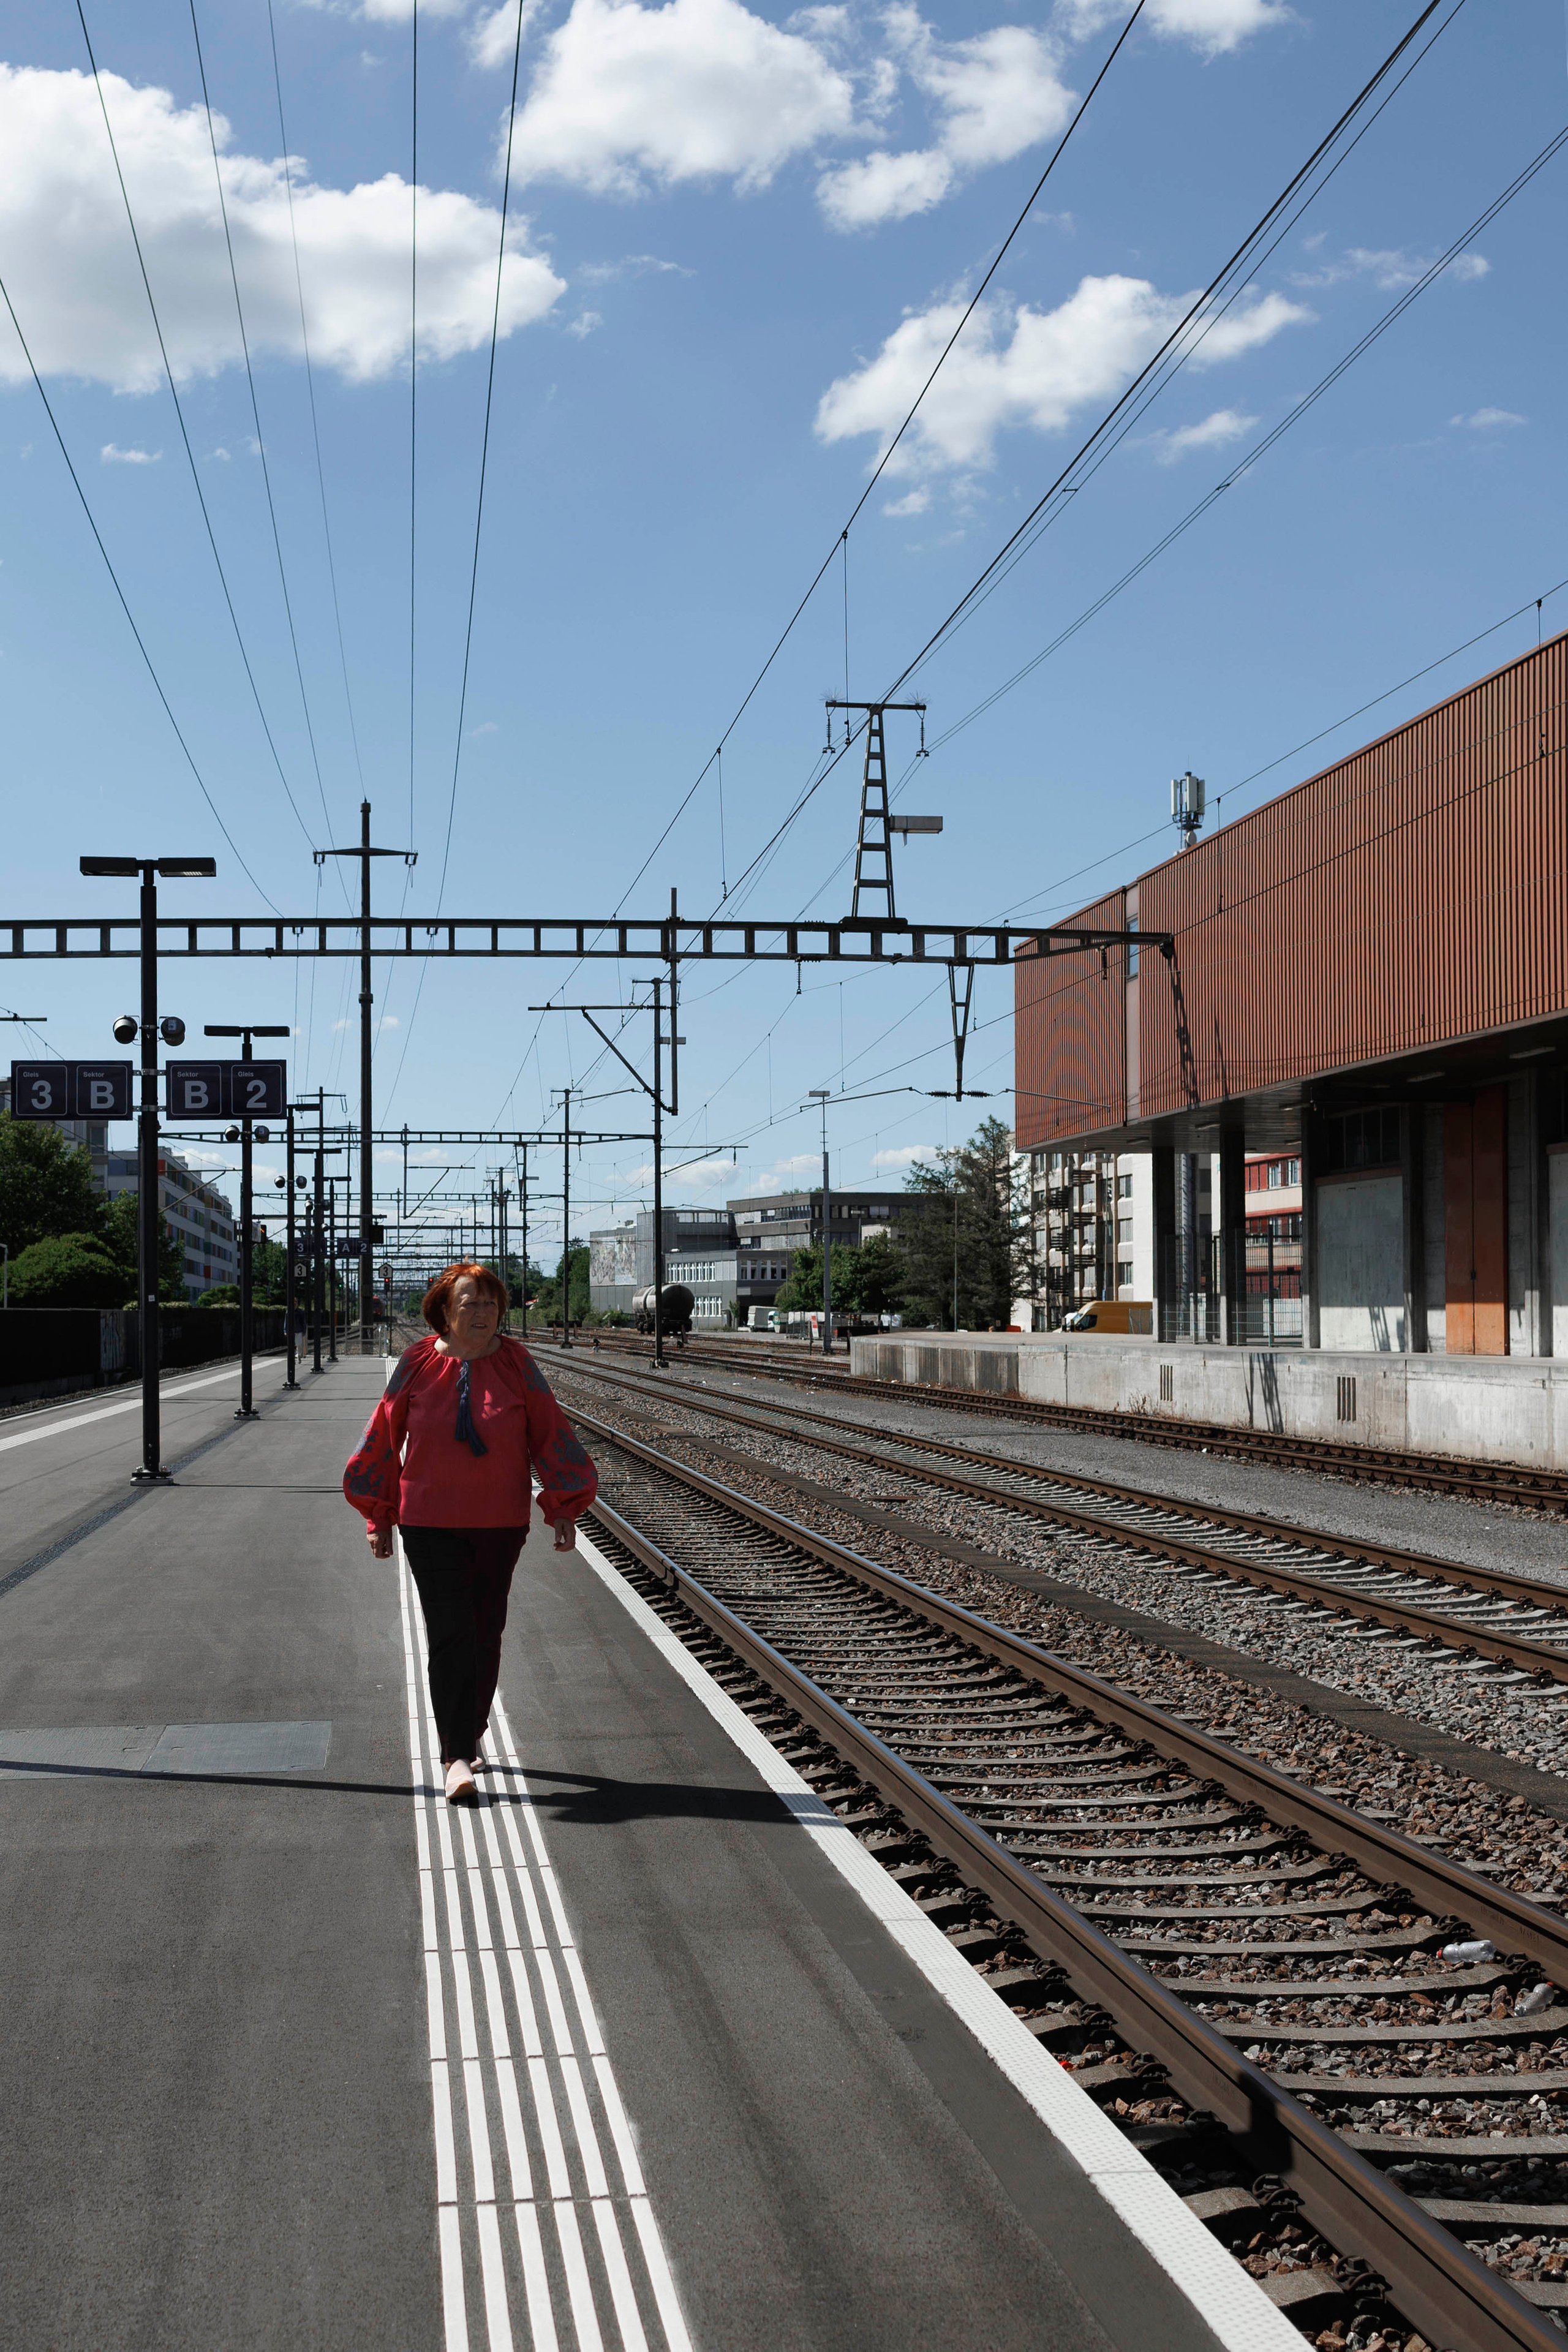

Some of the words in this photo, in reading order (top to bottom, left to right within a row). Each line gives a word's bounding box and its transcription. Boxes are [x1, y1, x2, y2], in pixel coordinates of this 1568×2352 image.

[31, 1080, 52, 1109] 3
[90, 1080, 115, 1109] B
[184, 1080, 209, 1109] B
[246, 1079, 267, 1108] 2
[297, 1243, 304, 1252] 3
[342, 1243, 350, 1252] A
[360, 1243, 367, 1252] 2
[297, 1265, 303, 1276] 3
[383, 1267, 388, 1276] 3
